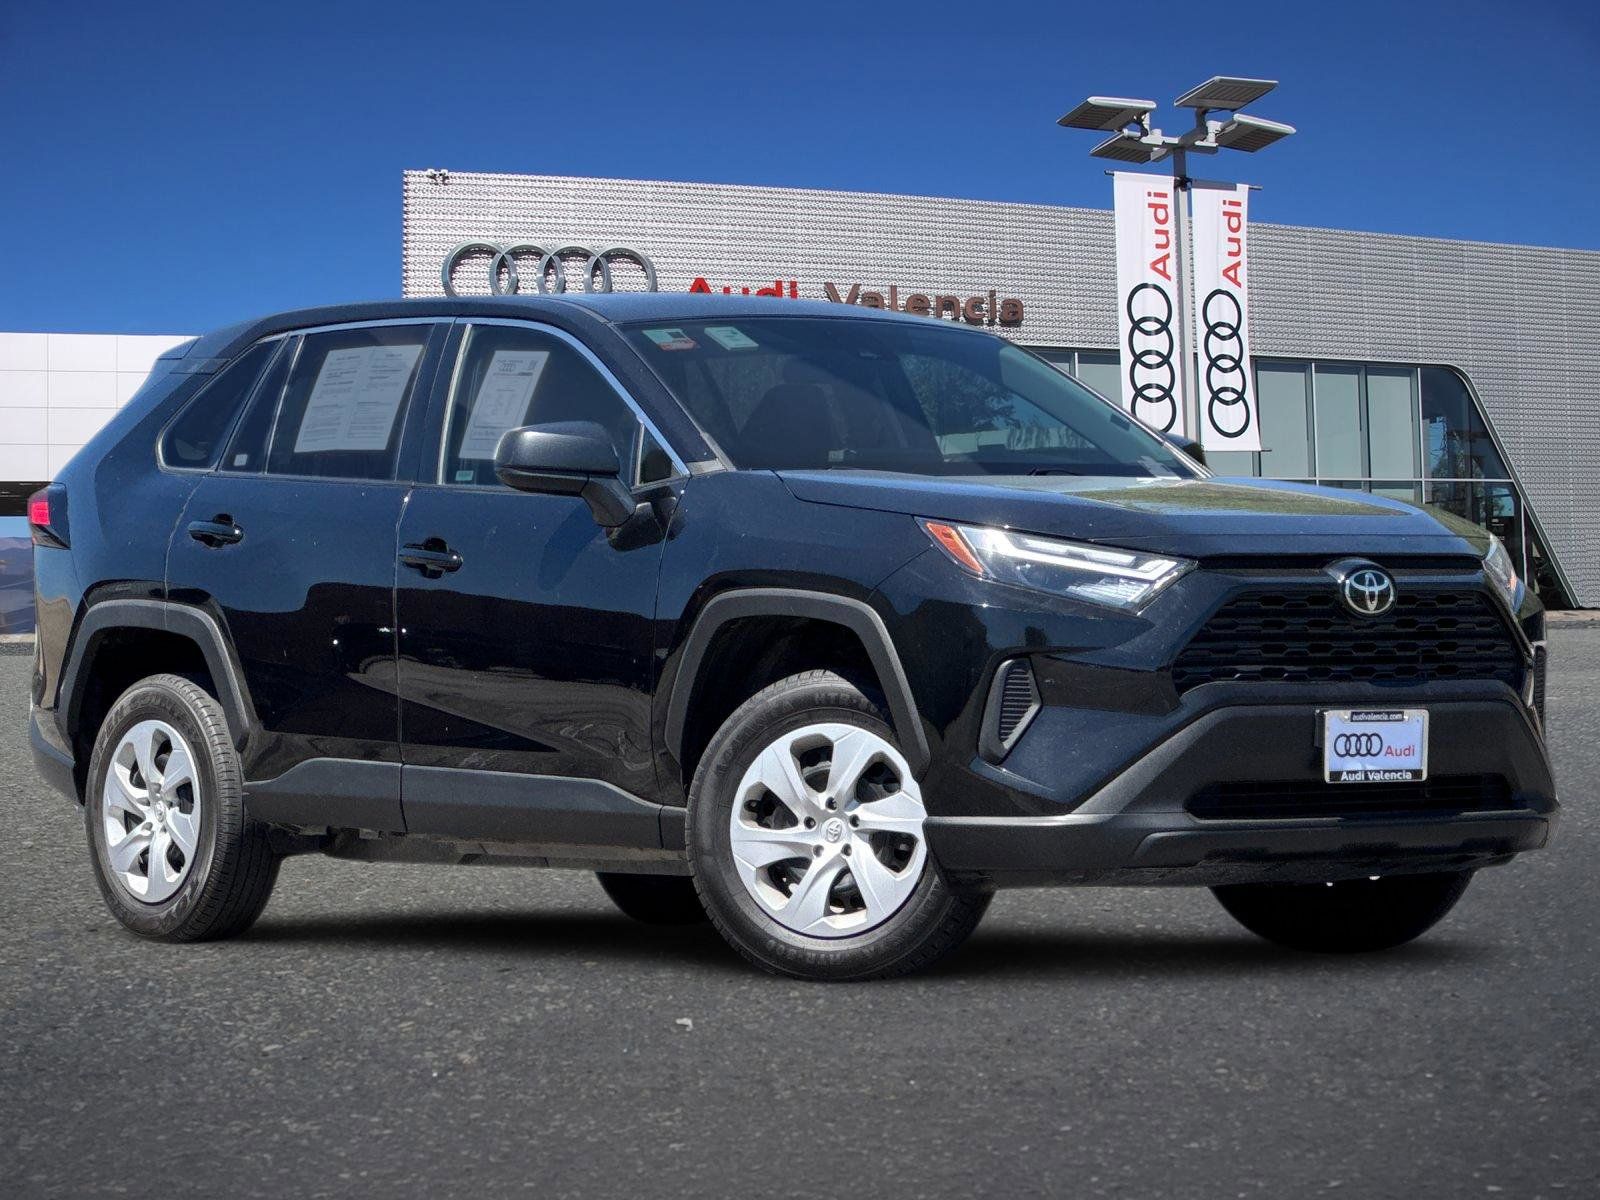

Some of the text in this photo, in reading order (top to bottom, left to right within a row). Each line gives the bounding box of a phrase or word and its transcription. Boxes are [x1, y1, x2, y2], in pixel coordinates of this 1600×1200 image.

[1147, 191, 1171, 281] Audi
[1222, 199, 1242, 288] Audi
[823, 281, 1024, 327] Valencia
[1352, 712, 1403, 721] audivalencia.com
[1384, 745, 1415, 757] Audi
[1341, 770, 1412, 781] Audi Valencia
